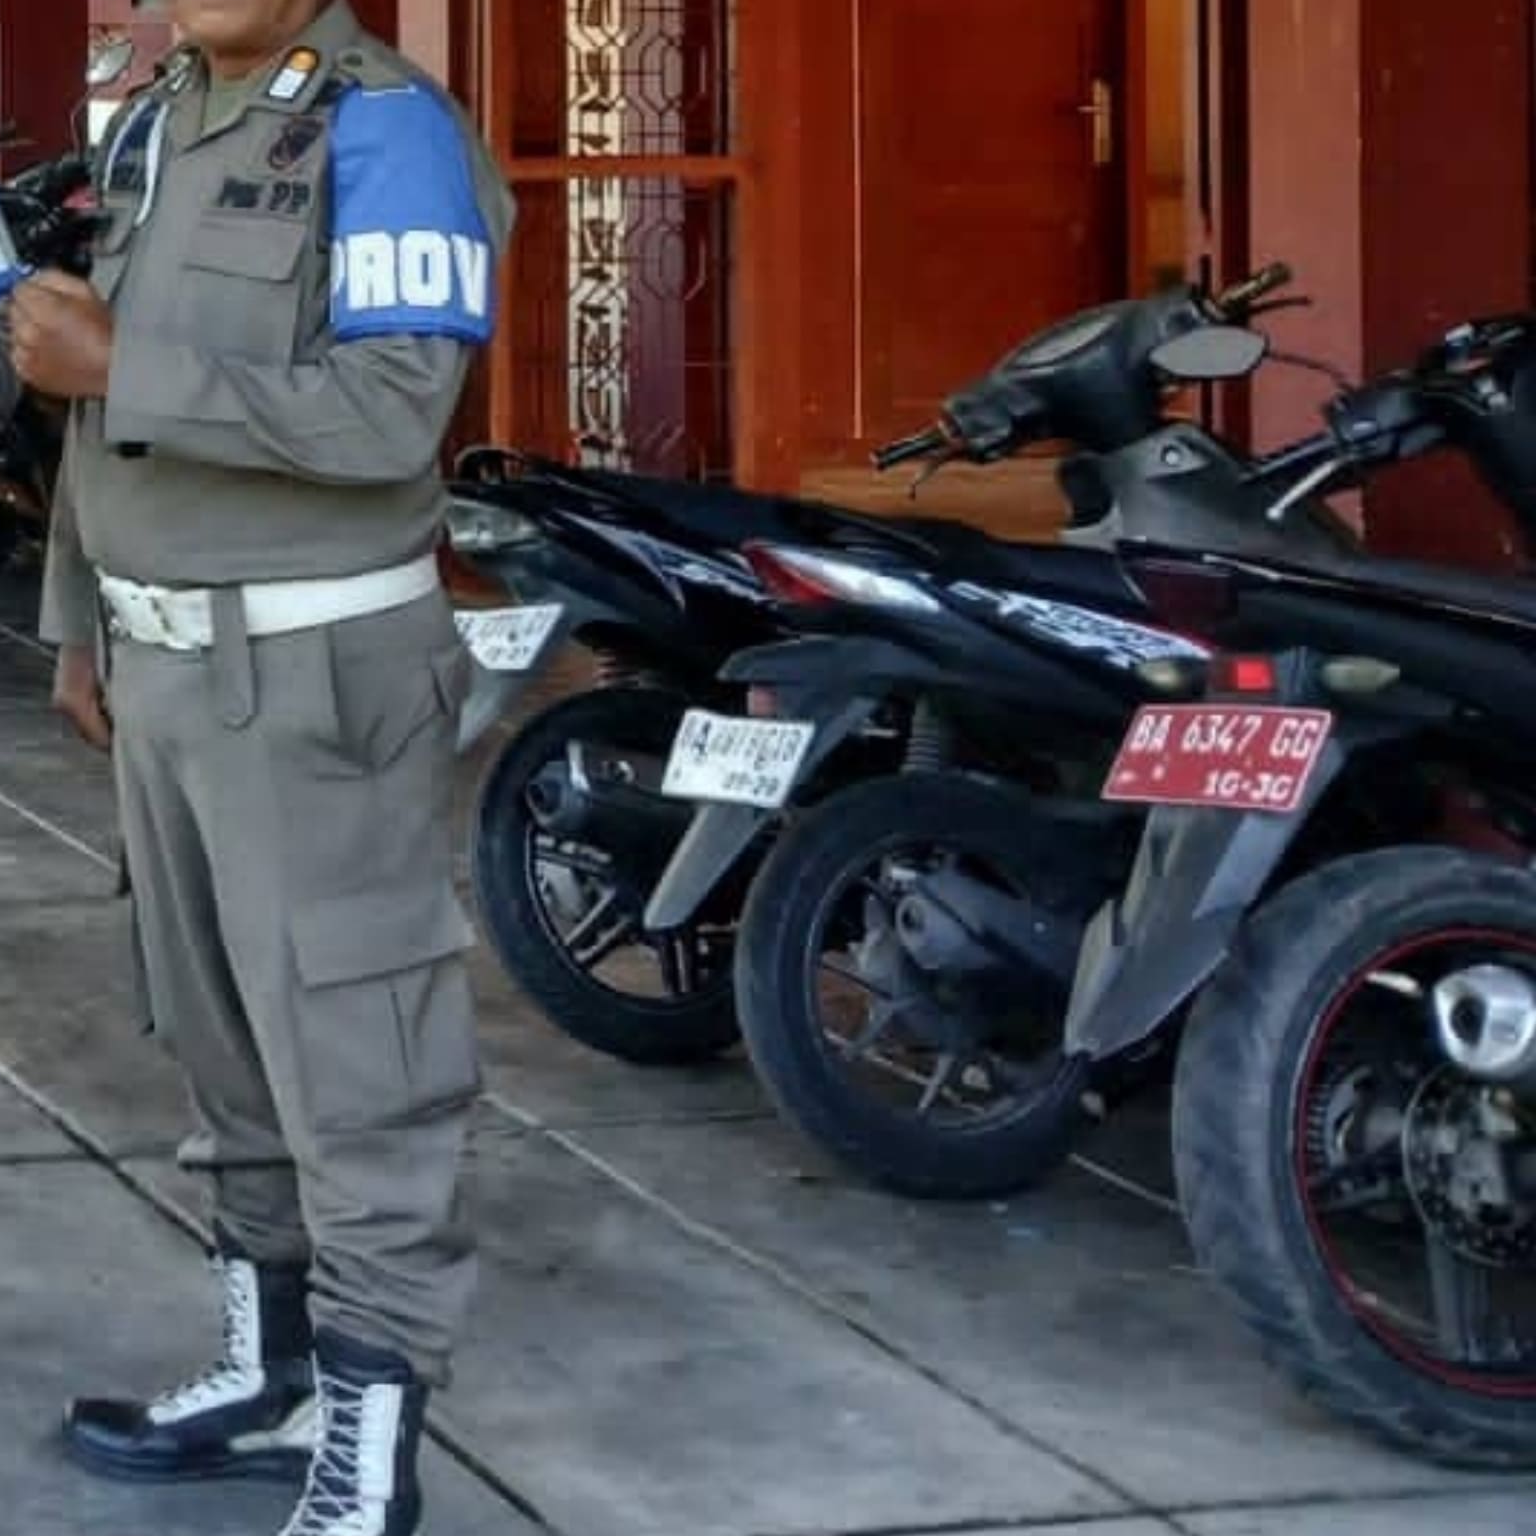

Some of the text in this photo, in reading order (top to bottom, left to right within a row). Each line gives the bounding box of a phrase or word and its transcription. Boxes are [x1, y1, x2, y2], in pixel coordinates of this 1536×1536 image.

[1129, 714, 1320, 760] BA 6347 GG
